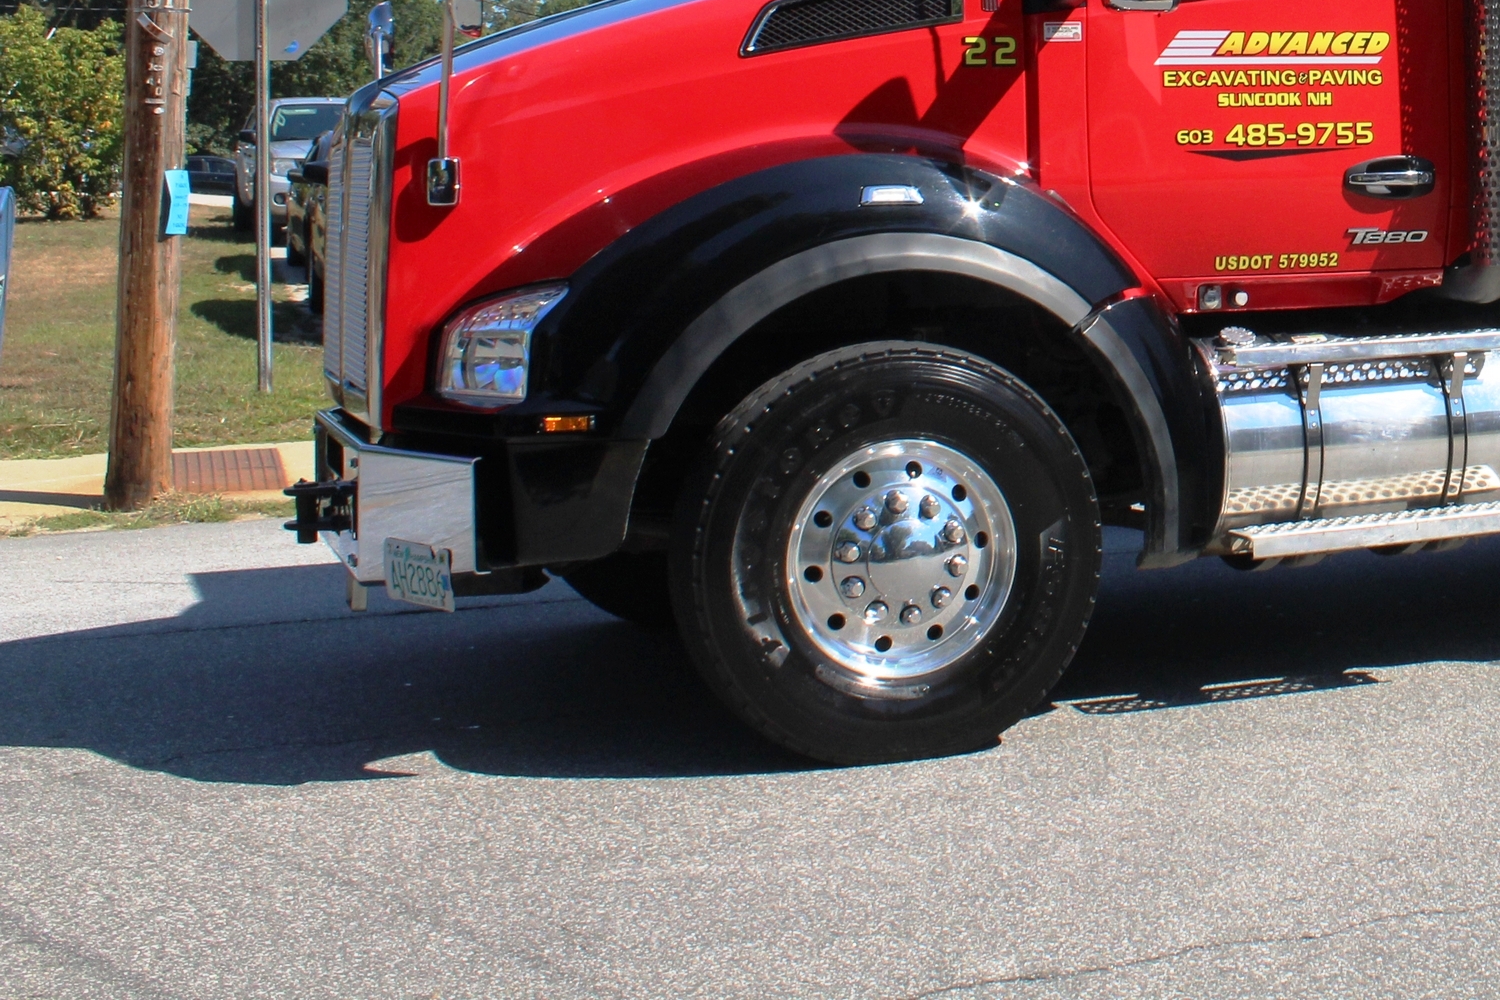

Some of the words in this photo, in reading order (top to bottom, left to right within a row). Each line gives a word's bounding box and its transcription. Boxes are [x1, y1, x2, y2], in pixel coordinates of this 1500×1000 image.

[964, 36, 1017, 65] 22
[1215, 31, 1391, 56] ADVANCED
[1162, 70, 1297, 88] EXCAVATING
[1298, 72, 1308, 85] &
[1308, 69, 1383, 86] PAVING
[1217, 92, 1302, 107] SUNCOOK
[1307, 92, 1332, 106] NH
[1176, 129, 1214, 145] 603
[1224, 122, 1375, 147] 485-9755
[1347, 227, 1429, 245] T880
[1214, 254, 1273, 271] USDOT
[1278, 252, 1340, 269] 579952
